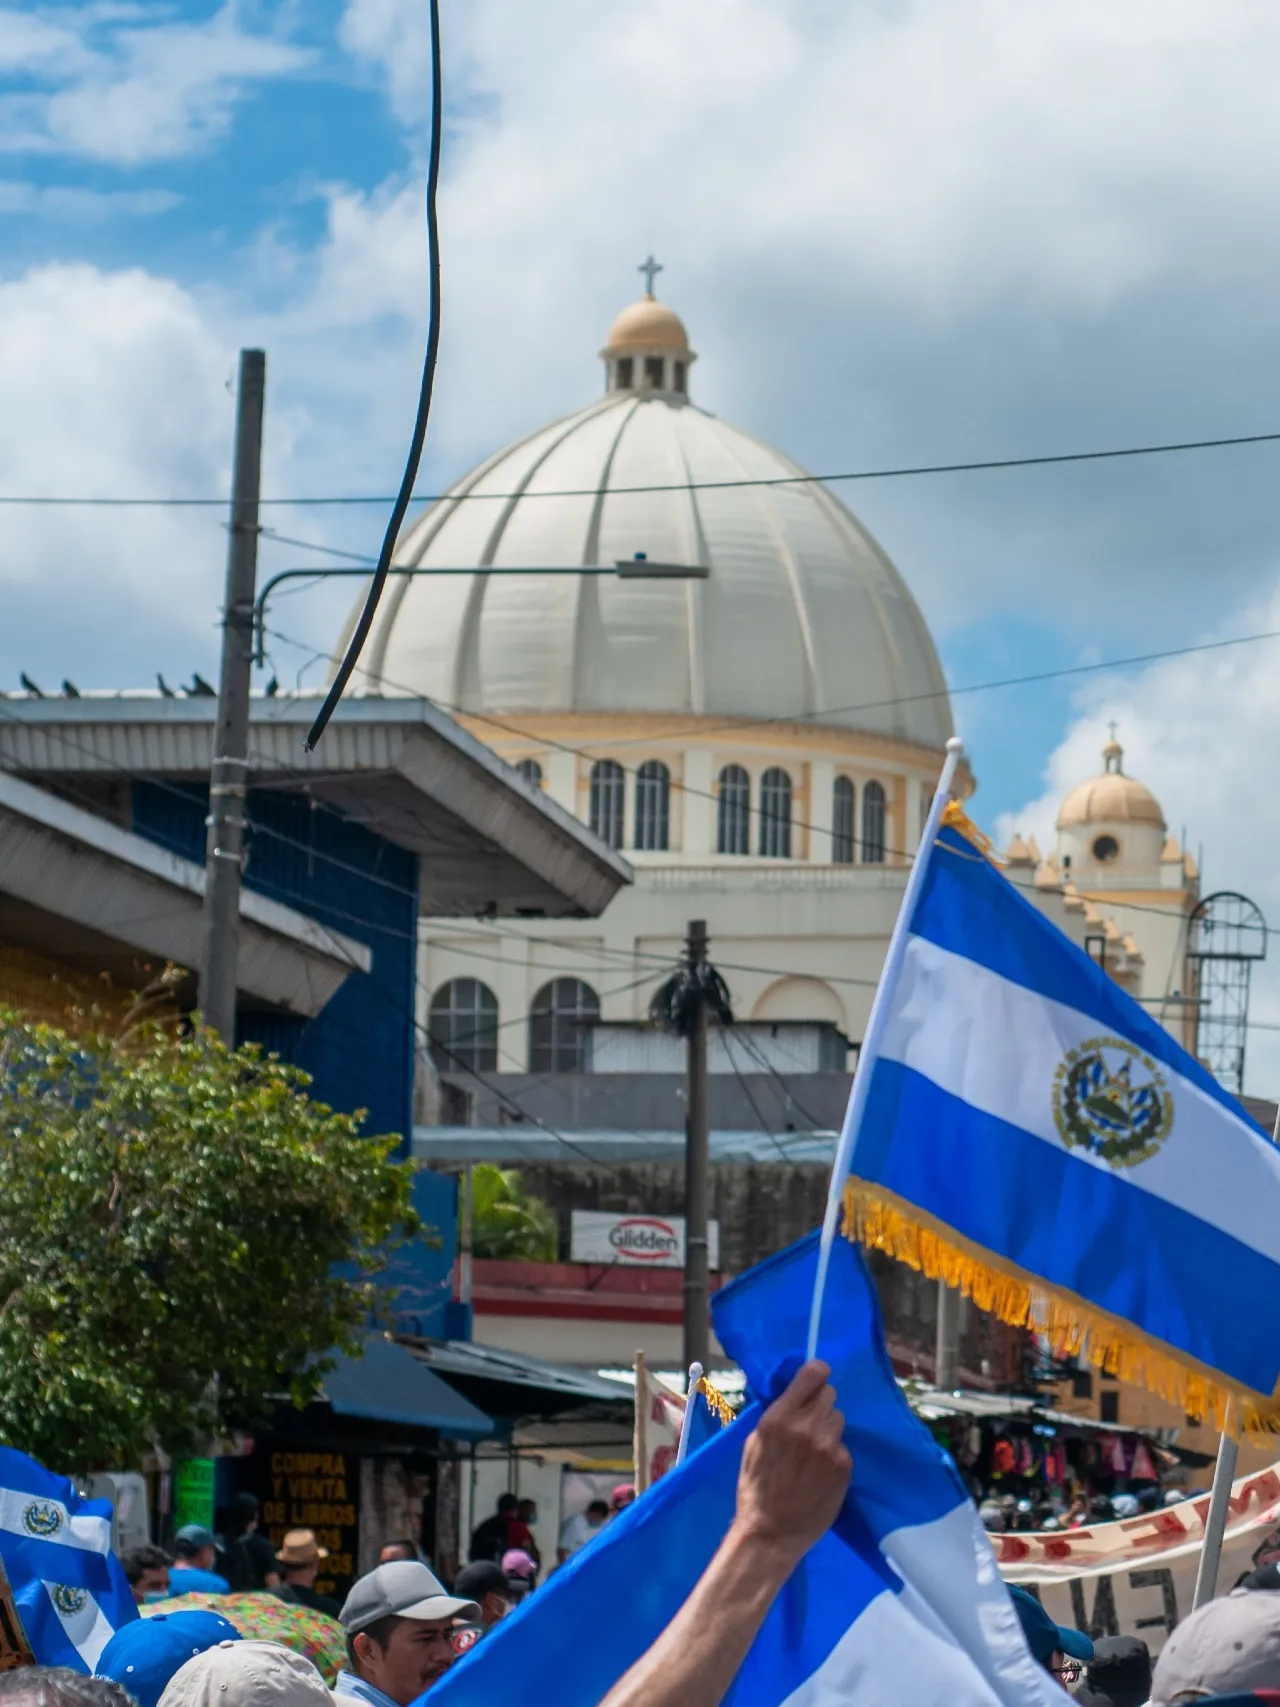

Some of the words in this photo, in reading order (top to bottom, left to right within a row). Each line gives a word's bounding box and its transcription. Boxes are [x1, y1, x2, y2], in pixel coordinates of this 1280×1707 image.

[608, 1227, 678, 1251] Glidden
[271, 1452, 346, 1476] COMPRA
[272, 1477, 284, 1498] Y
[287, 1477, 348, 1500] VENTA
[264, 1502, 286, 1524] DE
[291, 1503, 356, 1526] LIBROS
